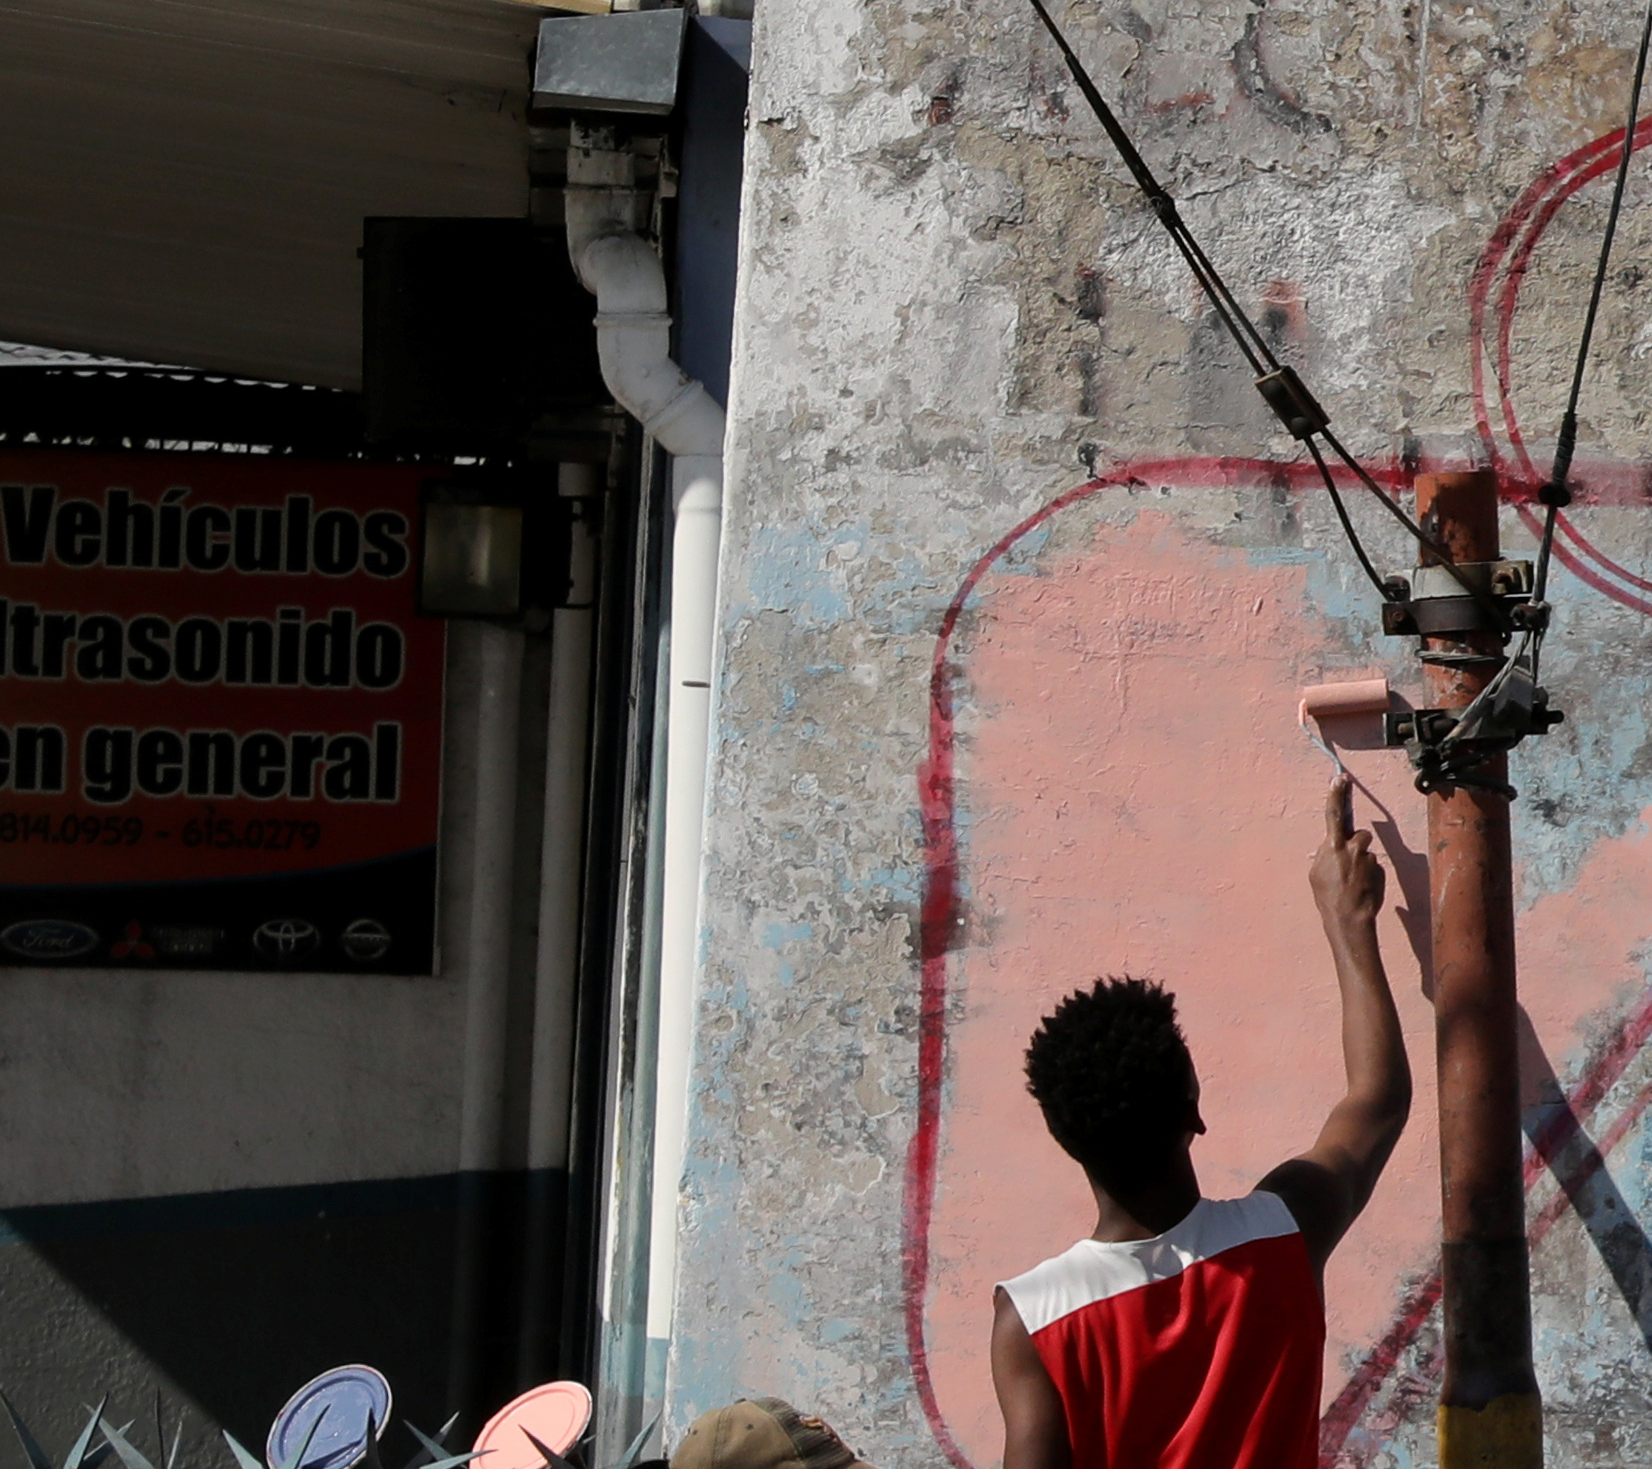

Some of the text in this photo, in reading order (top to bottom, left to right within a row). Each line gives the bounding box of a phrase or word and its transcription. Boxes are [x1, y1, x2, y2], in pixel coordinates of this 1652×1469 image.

[1, 485, 410, 579] Vehículos
[82, 719, 403, 807] general
[182, 816, 321, 852] 615.0279
